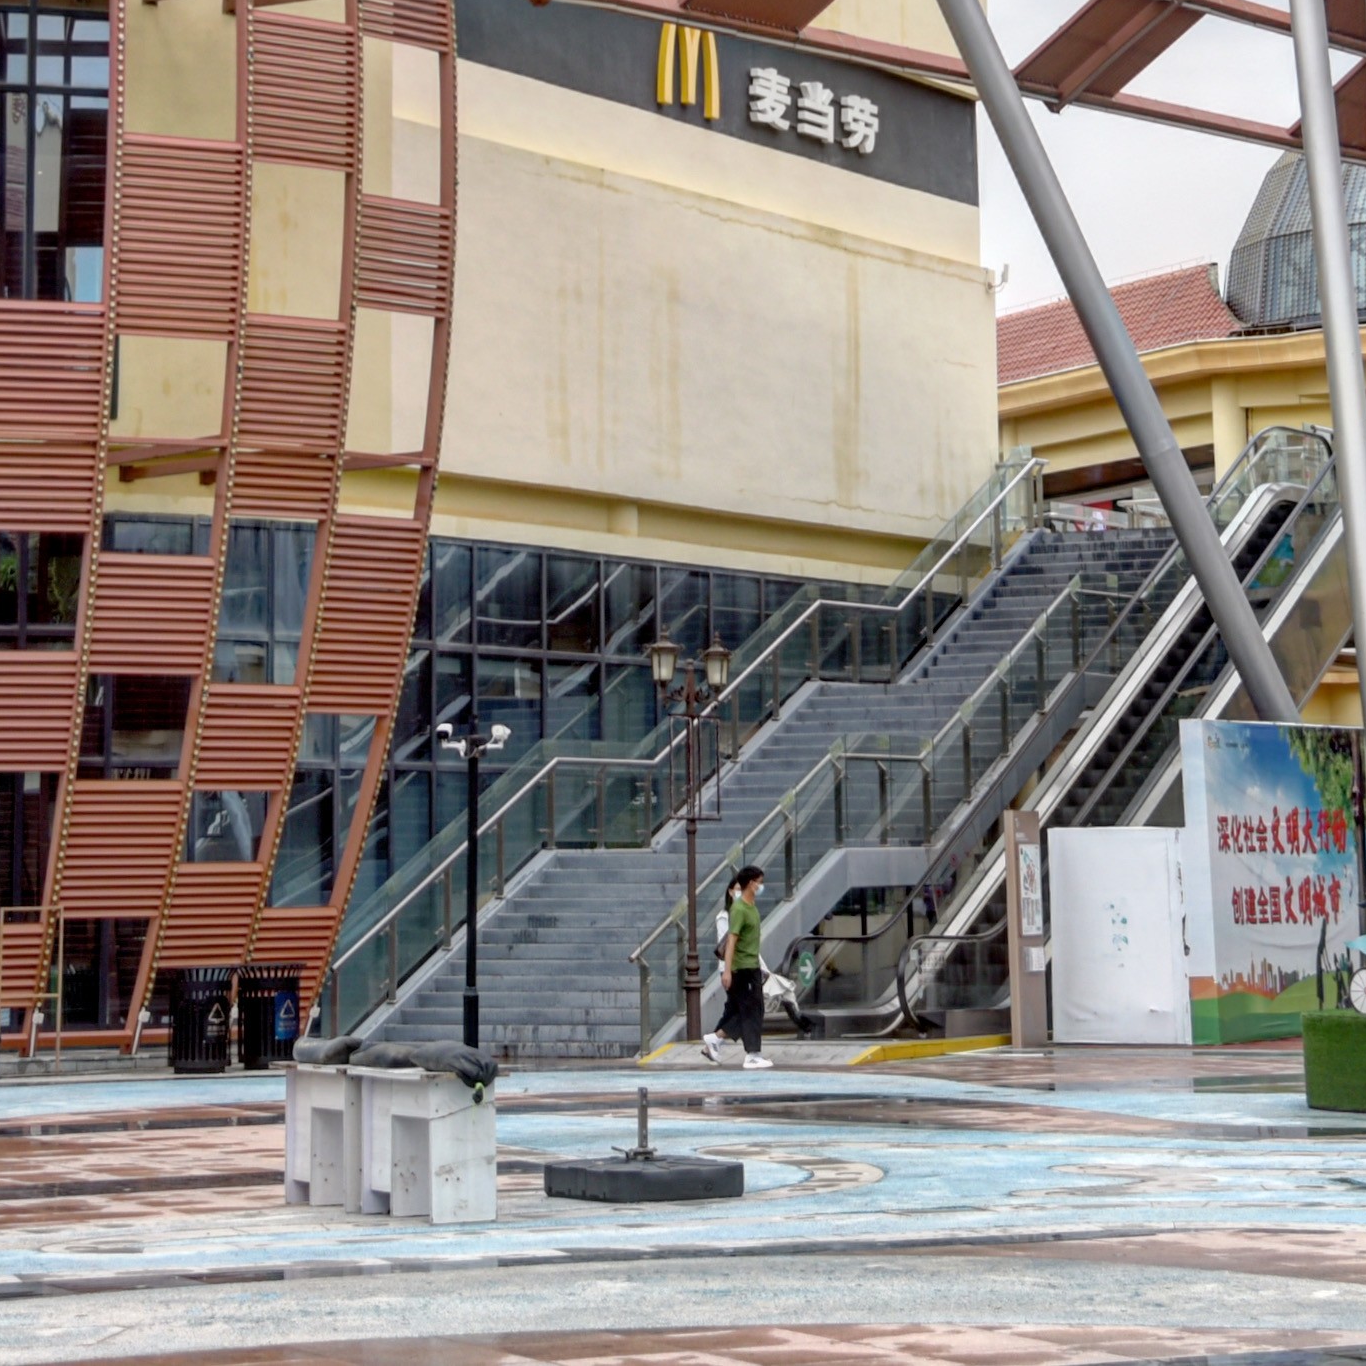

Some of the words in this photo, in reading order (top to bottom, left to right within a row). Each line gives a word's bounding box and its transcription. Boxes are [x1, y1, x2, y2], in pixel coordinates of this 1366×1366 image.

[749, 67, 879, 154] 麦当劳
[1217, 806, 1348, 856] 深化社会文明大行动
[1232, 873, 1342, 925] 创建全国文明城市
